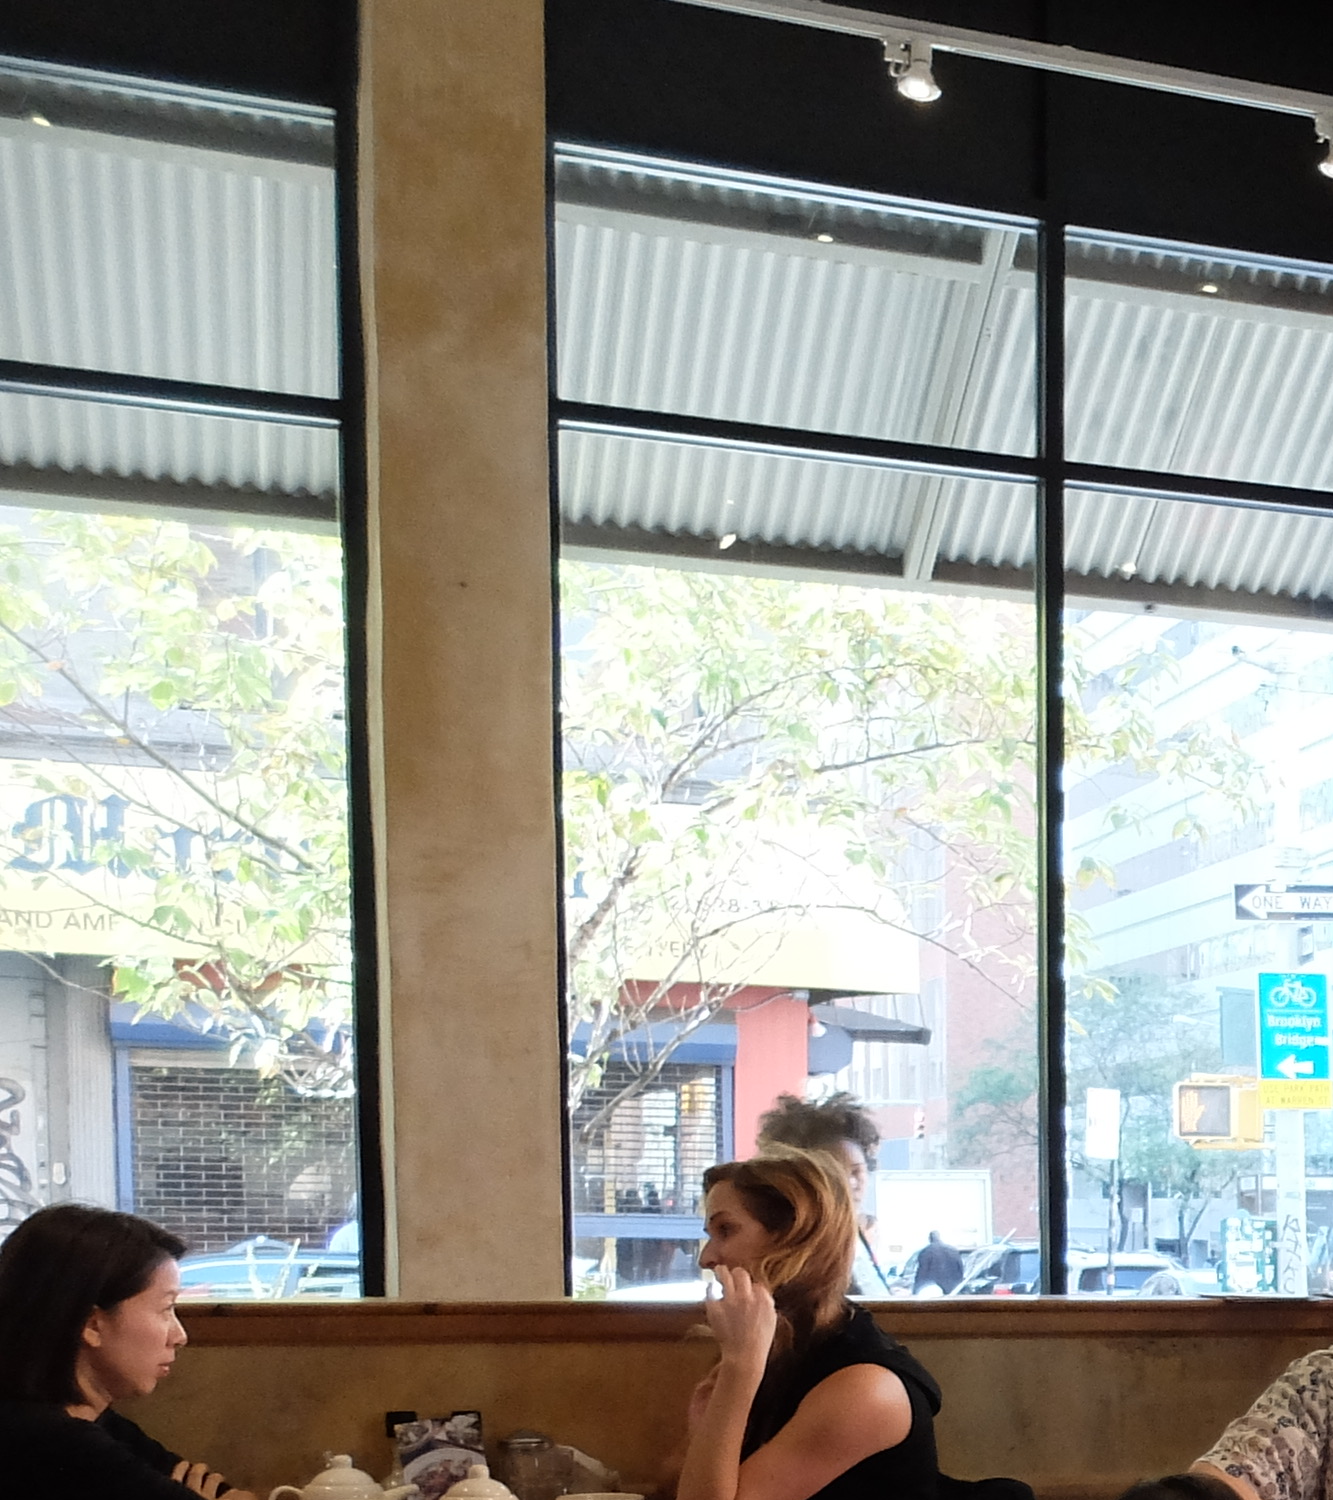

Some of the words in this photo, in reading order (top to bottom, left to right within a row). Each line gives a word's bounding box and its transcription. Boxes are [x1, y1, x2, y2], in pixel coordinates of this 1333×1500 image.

[1251, 895, 1284, 910] ONE
[1299, 895, 1333, 910] WAY
[1267, 1014, 1322, 1032] Brooklyn
[1274, 1033, 1315, 1049] Bridge
